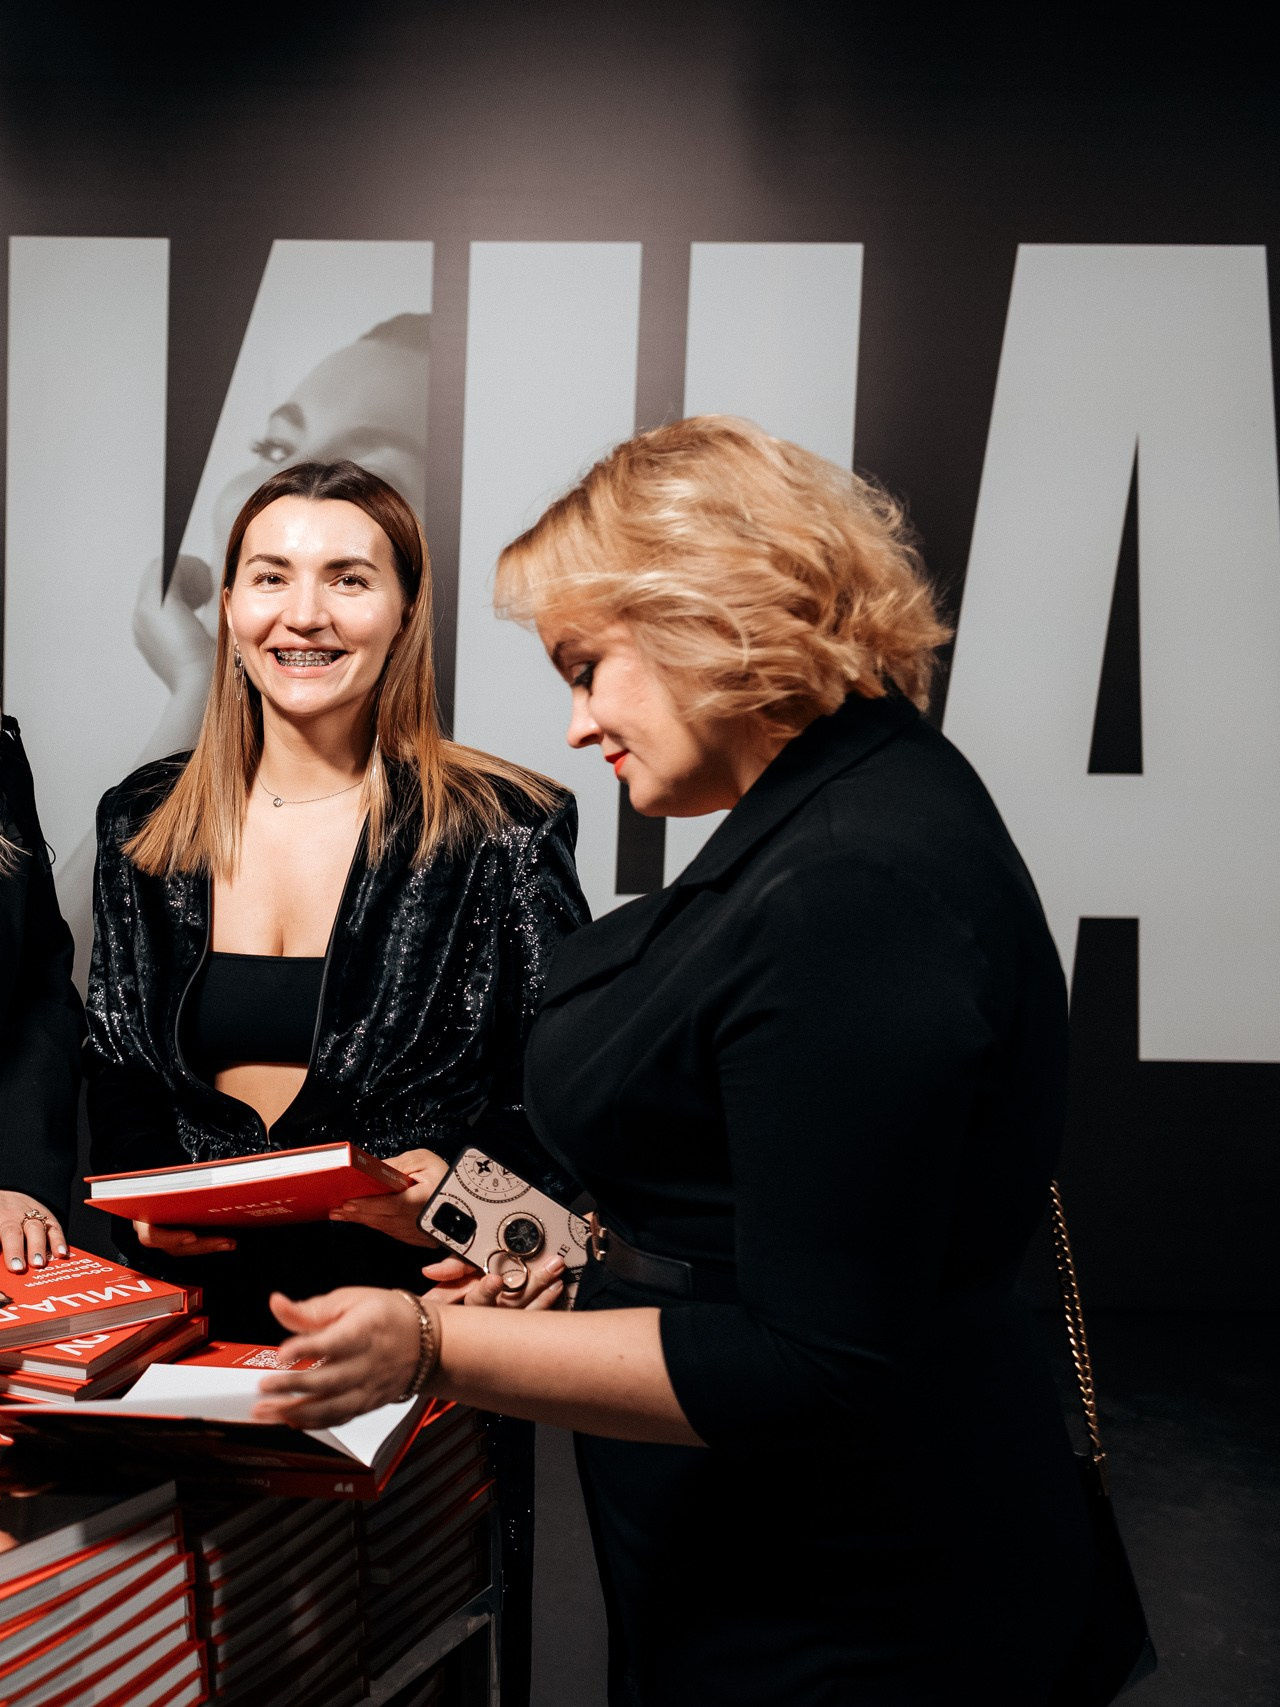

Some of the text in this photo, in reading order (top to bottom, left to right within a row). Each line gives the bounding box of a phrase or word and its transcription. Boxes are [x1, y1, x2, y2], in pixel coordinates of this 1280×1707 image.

[32, 1261, 102, 1280] Дальний
[35, 1258, 93, 1273] Восток
[24, 1266, 113, 1288] Объединяя
